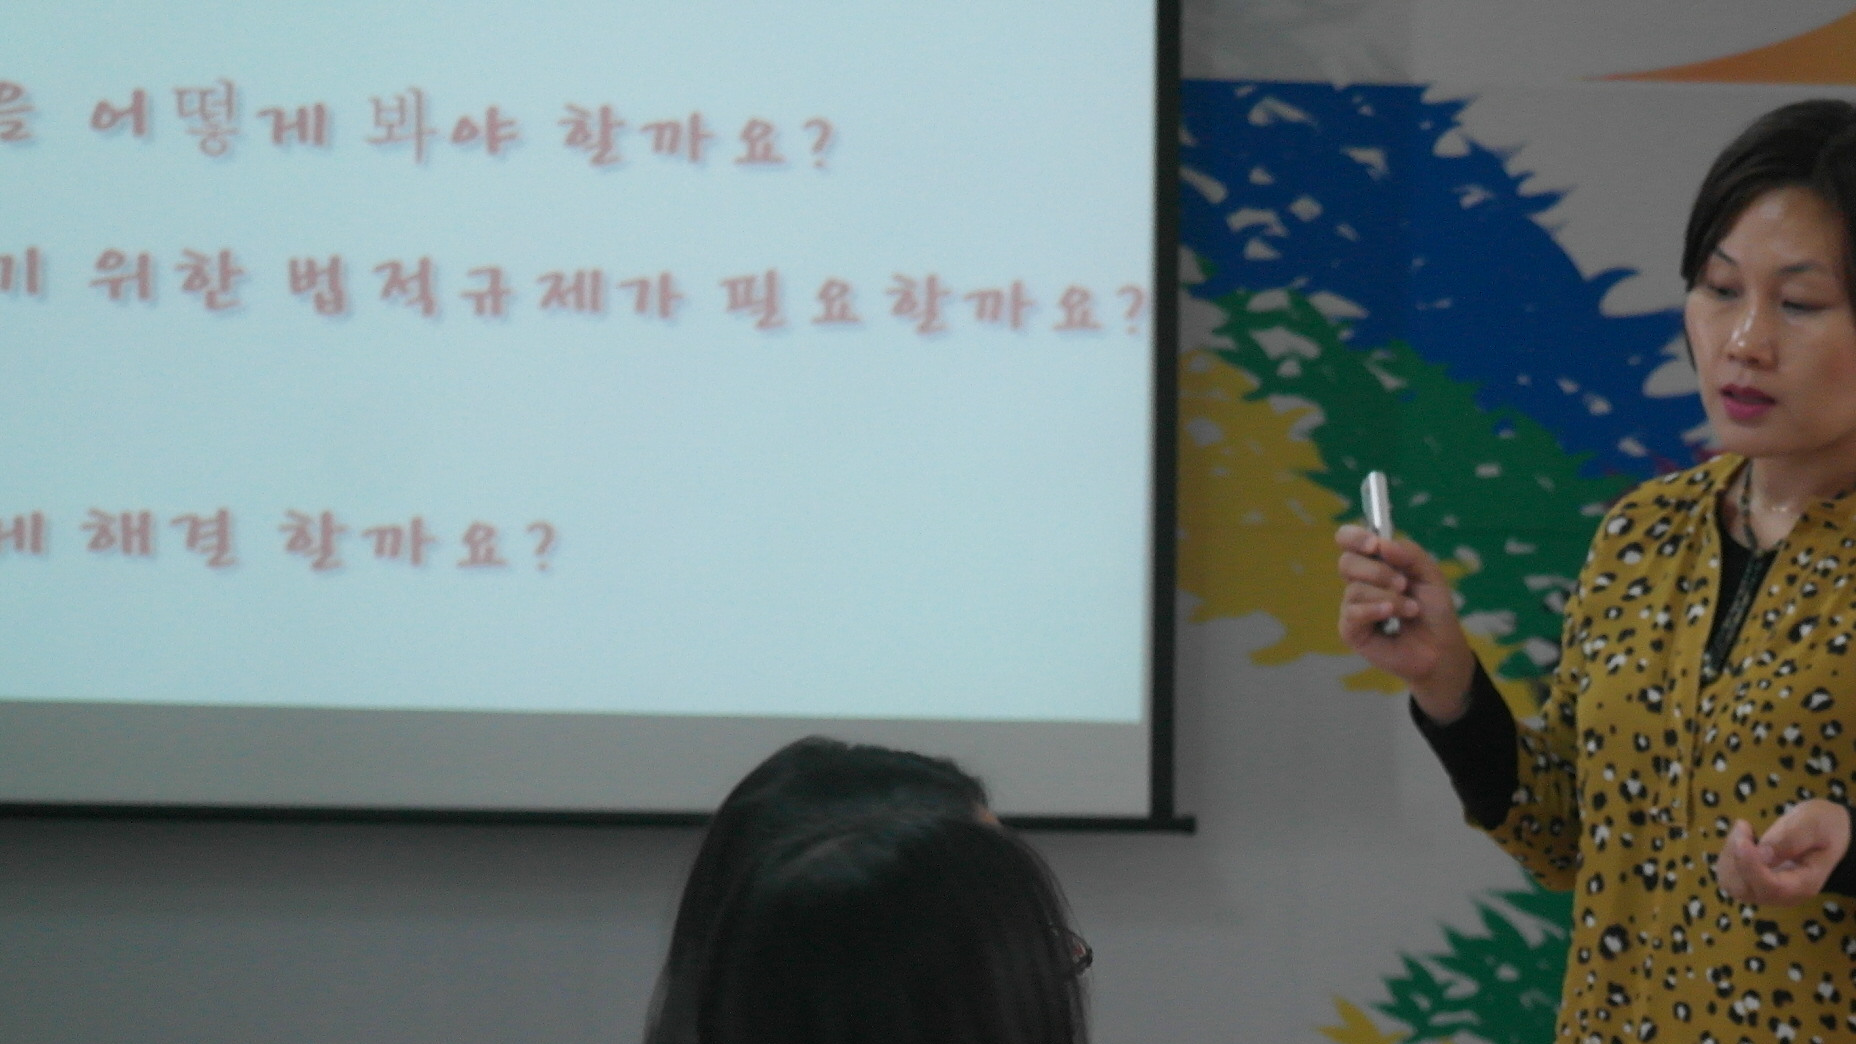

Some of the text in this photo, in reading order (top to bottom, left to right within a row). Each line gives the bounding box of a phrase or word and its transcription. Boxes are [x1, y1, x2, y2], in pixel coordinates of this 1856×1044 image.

[88, 77, 330, 158] 어떻게
[366, 85, 520, 165] 봐야
[558, 103, 836, 170] 할까요?
[89, 248, 245, 312] 위한
[81, 507, 238, 569] 해결
[278, 509, 558, 572] 할까요?
